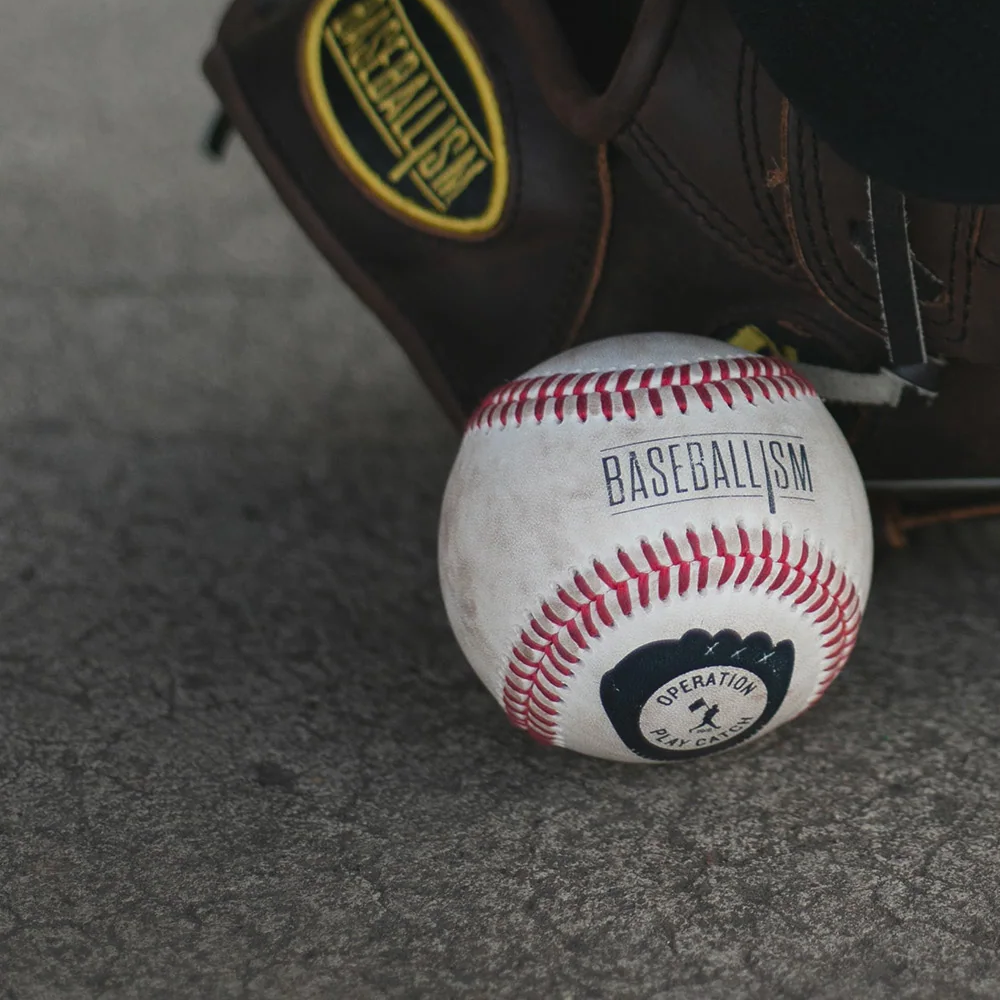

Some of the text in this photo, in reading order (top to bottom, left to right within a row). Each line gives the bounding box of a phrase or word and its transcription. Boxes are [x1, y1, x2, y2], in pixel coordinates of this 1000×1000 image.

[602, 439, 813, 514] BASEBALLISM
[656, 671, 757, 706] OPERATION
[650, 716, 753, 748] PLAY CATCH
